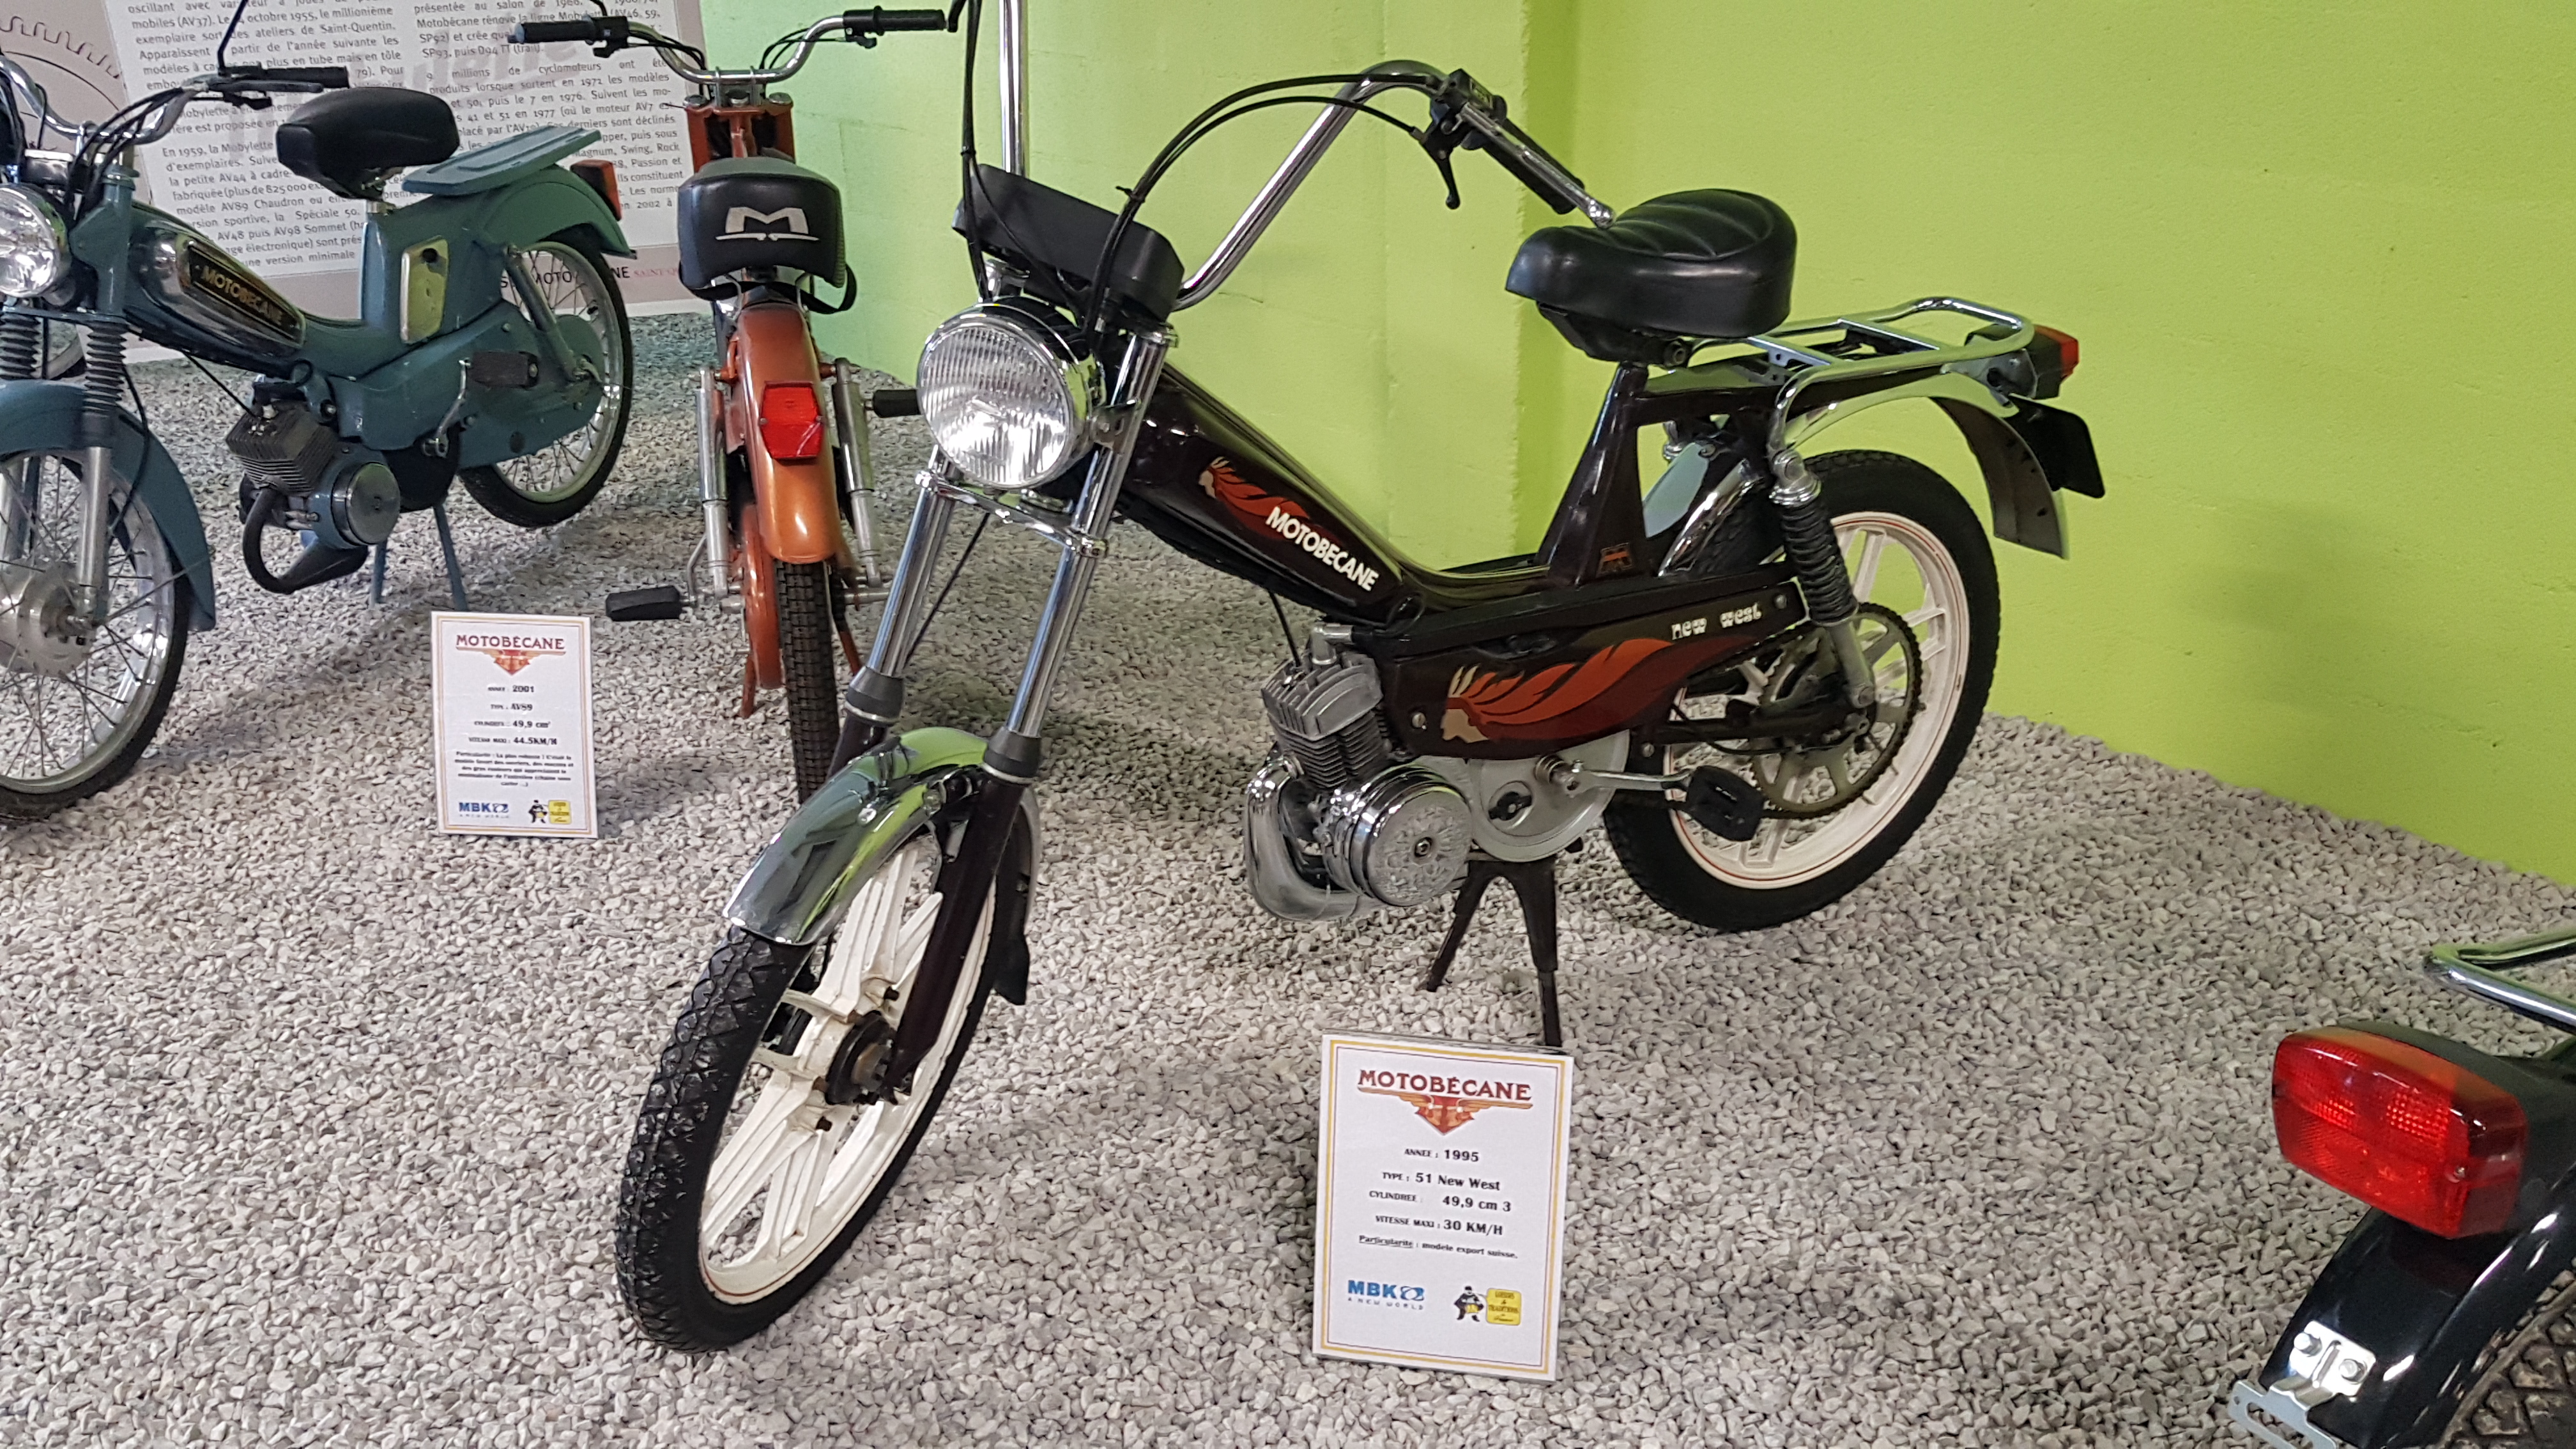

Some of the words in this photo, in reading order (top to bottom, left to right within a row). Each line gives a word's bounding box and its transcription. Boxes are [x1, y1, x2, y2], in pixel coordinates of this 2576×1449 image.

[128, 2, 176, 13] oscillant
[185, 1, 211, 10] avec
[247, 12, 287, 23] octobre
[319, 9, 330, 19] le
[332, 6, 394, 19] millionième
[414, 2, 466, 15] présentée
[475, 3, 487, 11] au
[132, 19, 176, 29] mobiles
[178, 15, 216, 28] (AV37).
[417, 17, 479, 29] Motobécane
[482, 15, 516, 26] rénove
[136, 33, 196, 45] exemplaire
[256, 27, 295, 38] ateliers
[301, 25, 315, 35] de
[454, 33, 463, 42] et
[467, 31, 488, 40] crée
[231, 44, 259, 56] partir
[267, 42, 280, 52] de
[288, 40, 326, 50] l'année
[333, 37, 377, 49] suivante
[383, 34, 399, 45] les
[454, 46, 476, 58] puis
[140, 47, 211, 61] Apparaissent
[293, 57, 305, 65] en
[309, 54, 333, 65] tube
[337, 53, 362, 63] mais
[365, 53, 378, 61] en
[381, 50, 402, 61] tôle
[143, 63, 190, 75] modèles
[194, 63, 200, 72] à
[380, 65, 405, 75] Pour
[452, 68, 491, 79] millions
[509, 66, 521, 76] de
[539, 63, 602, 75] cyclomoteurs
[619, 60, 635, 70] ont
[430, 84, 471, 95] produits
[477, 82, 514, 93] lorsque
[521, 80, 557, 89] sortent
[581, 78, 603, 88] 1972
[608, 75, 623, 84] les
[629, 72, 670, 83] modèles
[451, 99, 461, 109] et
[488, 97, 510, 108] puis
[515, 95, 525, 104] le
[541, 95, 554, 103] en
[591, 89, 628, 100] Suivent
[632, 88, 648, 97] les
[484, 111, 494, 120] et
[515, 110, 528, 119] en
[533, 109, 556, 118] 1977
[582, 105, 592, 115] le
[596, 103, 630, 114] moteur
[195, 125, 211, 134] est
[214, 119, 263, 132] proposée
[487, 126, 503, 137] par
[611, 117, 632, 127] sont
[636, 114, 676, 126] déclinés
[631, 130, 651, 141] puis
[655, 130, 678, 139] sous
[162, 148, 176, 157] En
[208, 144, 218, 153] la
[221, 141, 273, 153] Mobylette
[657, 142, 680, 152] Rock
[631, 158, 668, 167] Passion
[671, 157, 682, 165] et
[169, 177, 179, 187] la
[184, 175, 215, 187] petite
[250, 170, 257, 180] à
[631, 170, 684, 182] constituent
[173, 188, 224, 201] fabriquée
[252, 185, 264, 195] de
[287, 183, 307, 192] 000
[629, 187, 646, 195] Les
[177, 204, 216, 215] modèle
[254, 197, 304, 209] Chaudron
[310, 196, 323, 204] ou
[666, 197, 673, 207] à
[275, 211, 284, 221] la
[295, 208, 339, 221] Spéciale
[249, 229, 271, 240] puis
[305, 222, 347, 234] Sommet
[316, 238, 338, 247] sont
[266, 254, 303, 266] version
[309, 250, 355, 263] minimale
[1266, 506, 1379, 592] MOTOBECANE
[1671, 618, 1707, 640] new
[1720, 602, 1762, 628] west
[456, 634, 565, 650] MOTOBÉCANE
[459, 802, 492, 813] MBK
[1358, 1069, 1532, 1101] MOTOBÉCANE
[1444, 1149, 1480, 1162] 1995
[1383, 1172, 1404, 1181] TYPE
[1415, 1172, 1432, 1183] 51
[1438, 1175, 1465, 1187] New
[1469, 1177, 1501, 1191] West
[1442, 1195, 1474, 1208] 49,9
[1478, 1200, 1498, 1211] cm
[1503, 1201, 1512, 1212] 3
[1376, 1215, 1411, 1225] VITESSE
[1443, 1220, 1462, 1230] 30
[1466, 1222, 1503, 1236] KM/H
[1456, 1246, 1484, 1255] export
[1348, 1280, 1397, 1300] MBK
